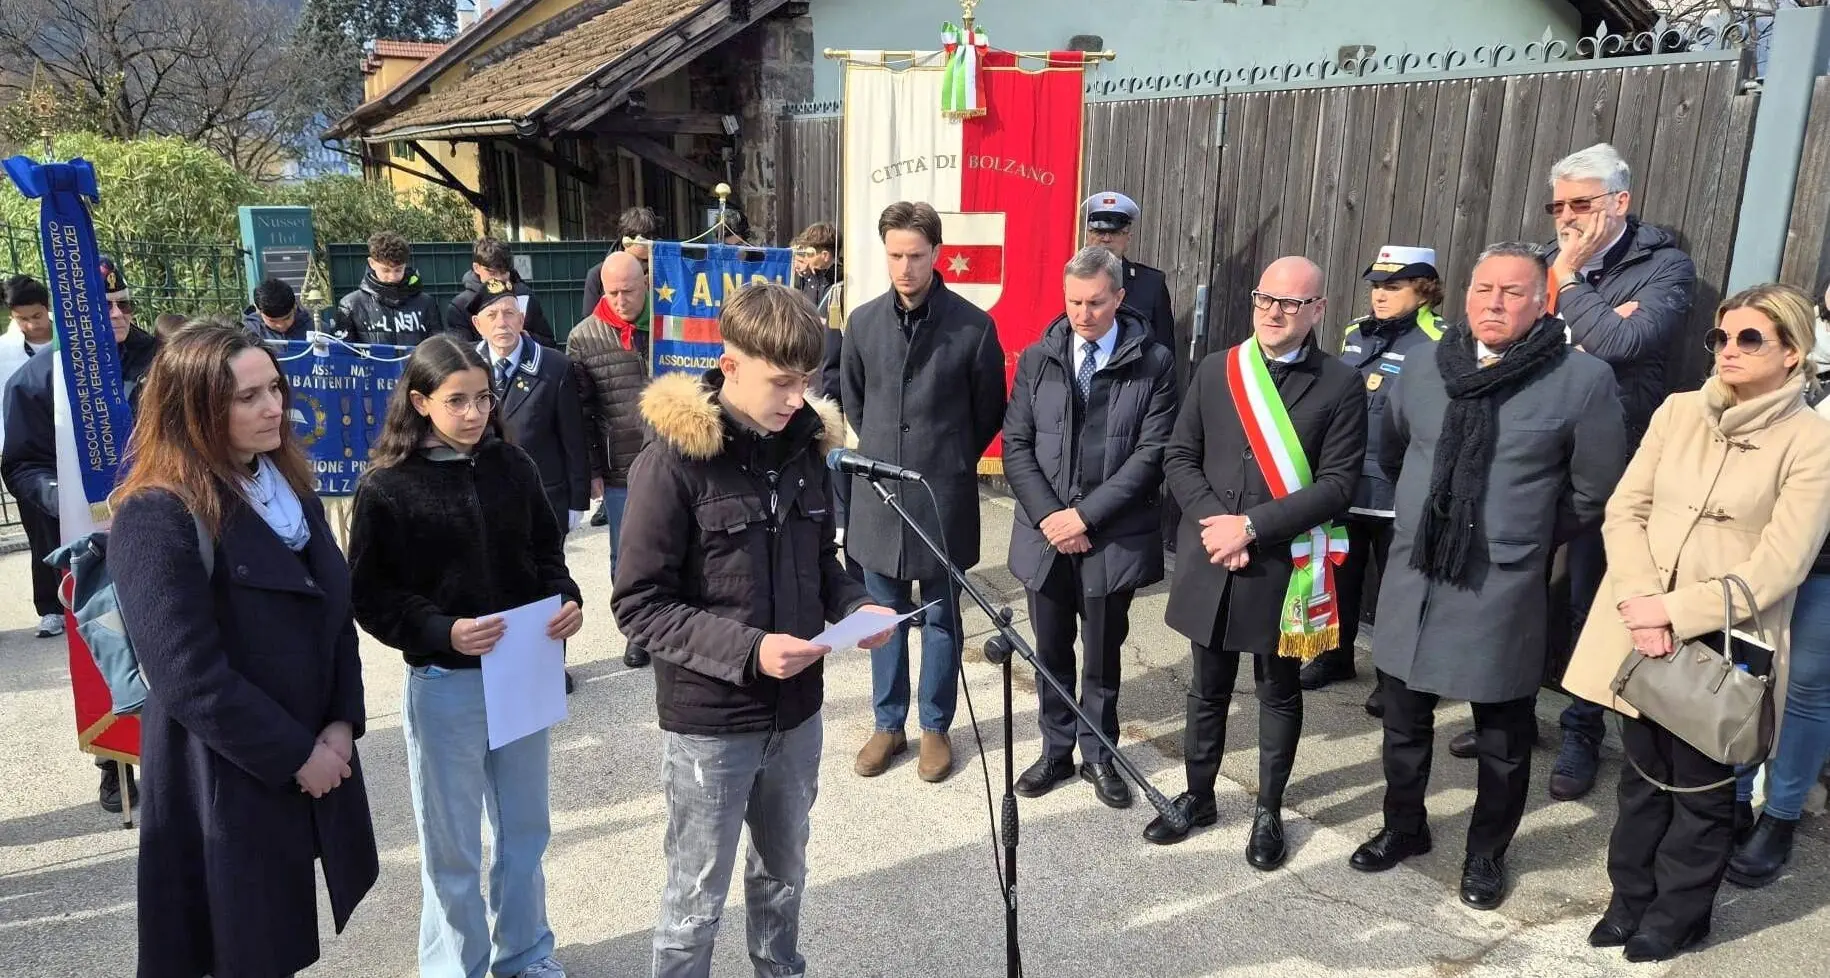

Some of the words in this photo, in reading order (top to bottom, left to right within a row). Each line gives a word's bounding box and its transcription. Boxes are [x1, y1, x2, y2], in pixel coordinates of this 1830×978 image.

[871, 155, 928, 184] CITTÀ
[935, 154, 957, 169] DI
[969, 155, 1055, 186] BOLZANO
[48, 221, 65, 258] STATO
[257, 216, 305, 228] Nusser
[55, 259, 67, 272] DI
[63, 225, 90, 312] STAATSPOLIZEI
[58, 273, 75, 319] POLIZIA
[80, 315, 95, 339] DER
[66, 320, 88, 387] NAZIONALE
[84, 339, 103, 395] VERBAND
[77, 388, 103, 472] ASSOCIAZIONE
[95, 396, 118, 466] NATIONALER
